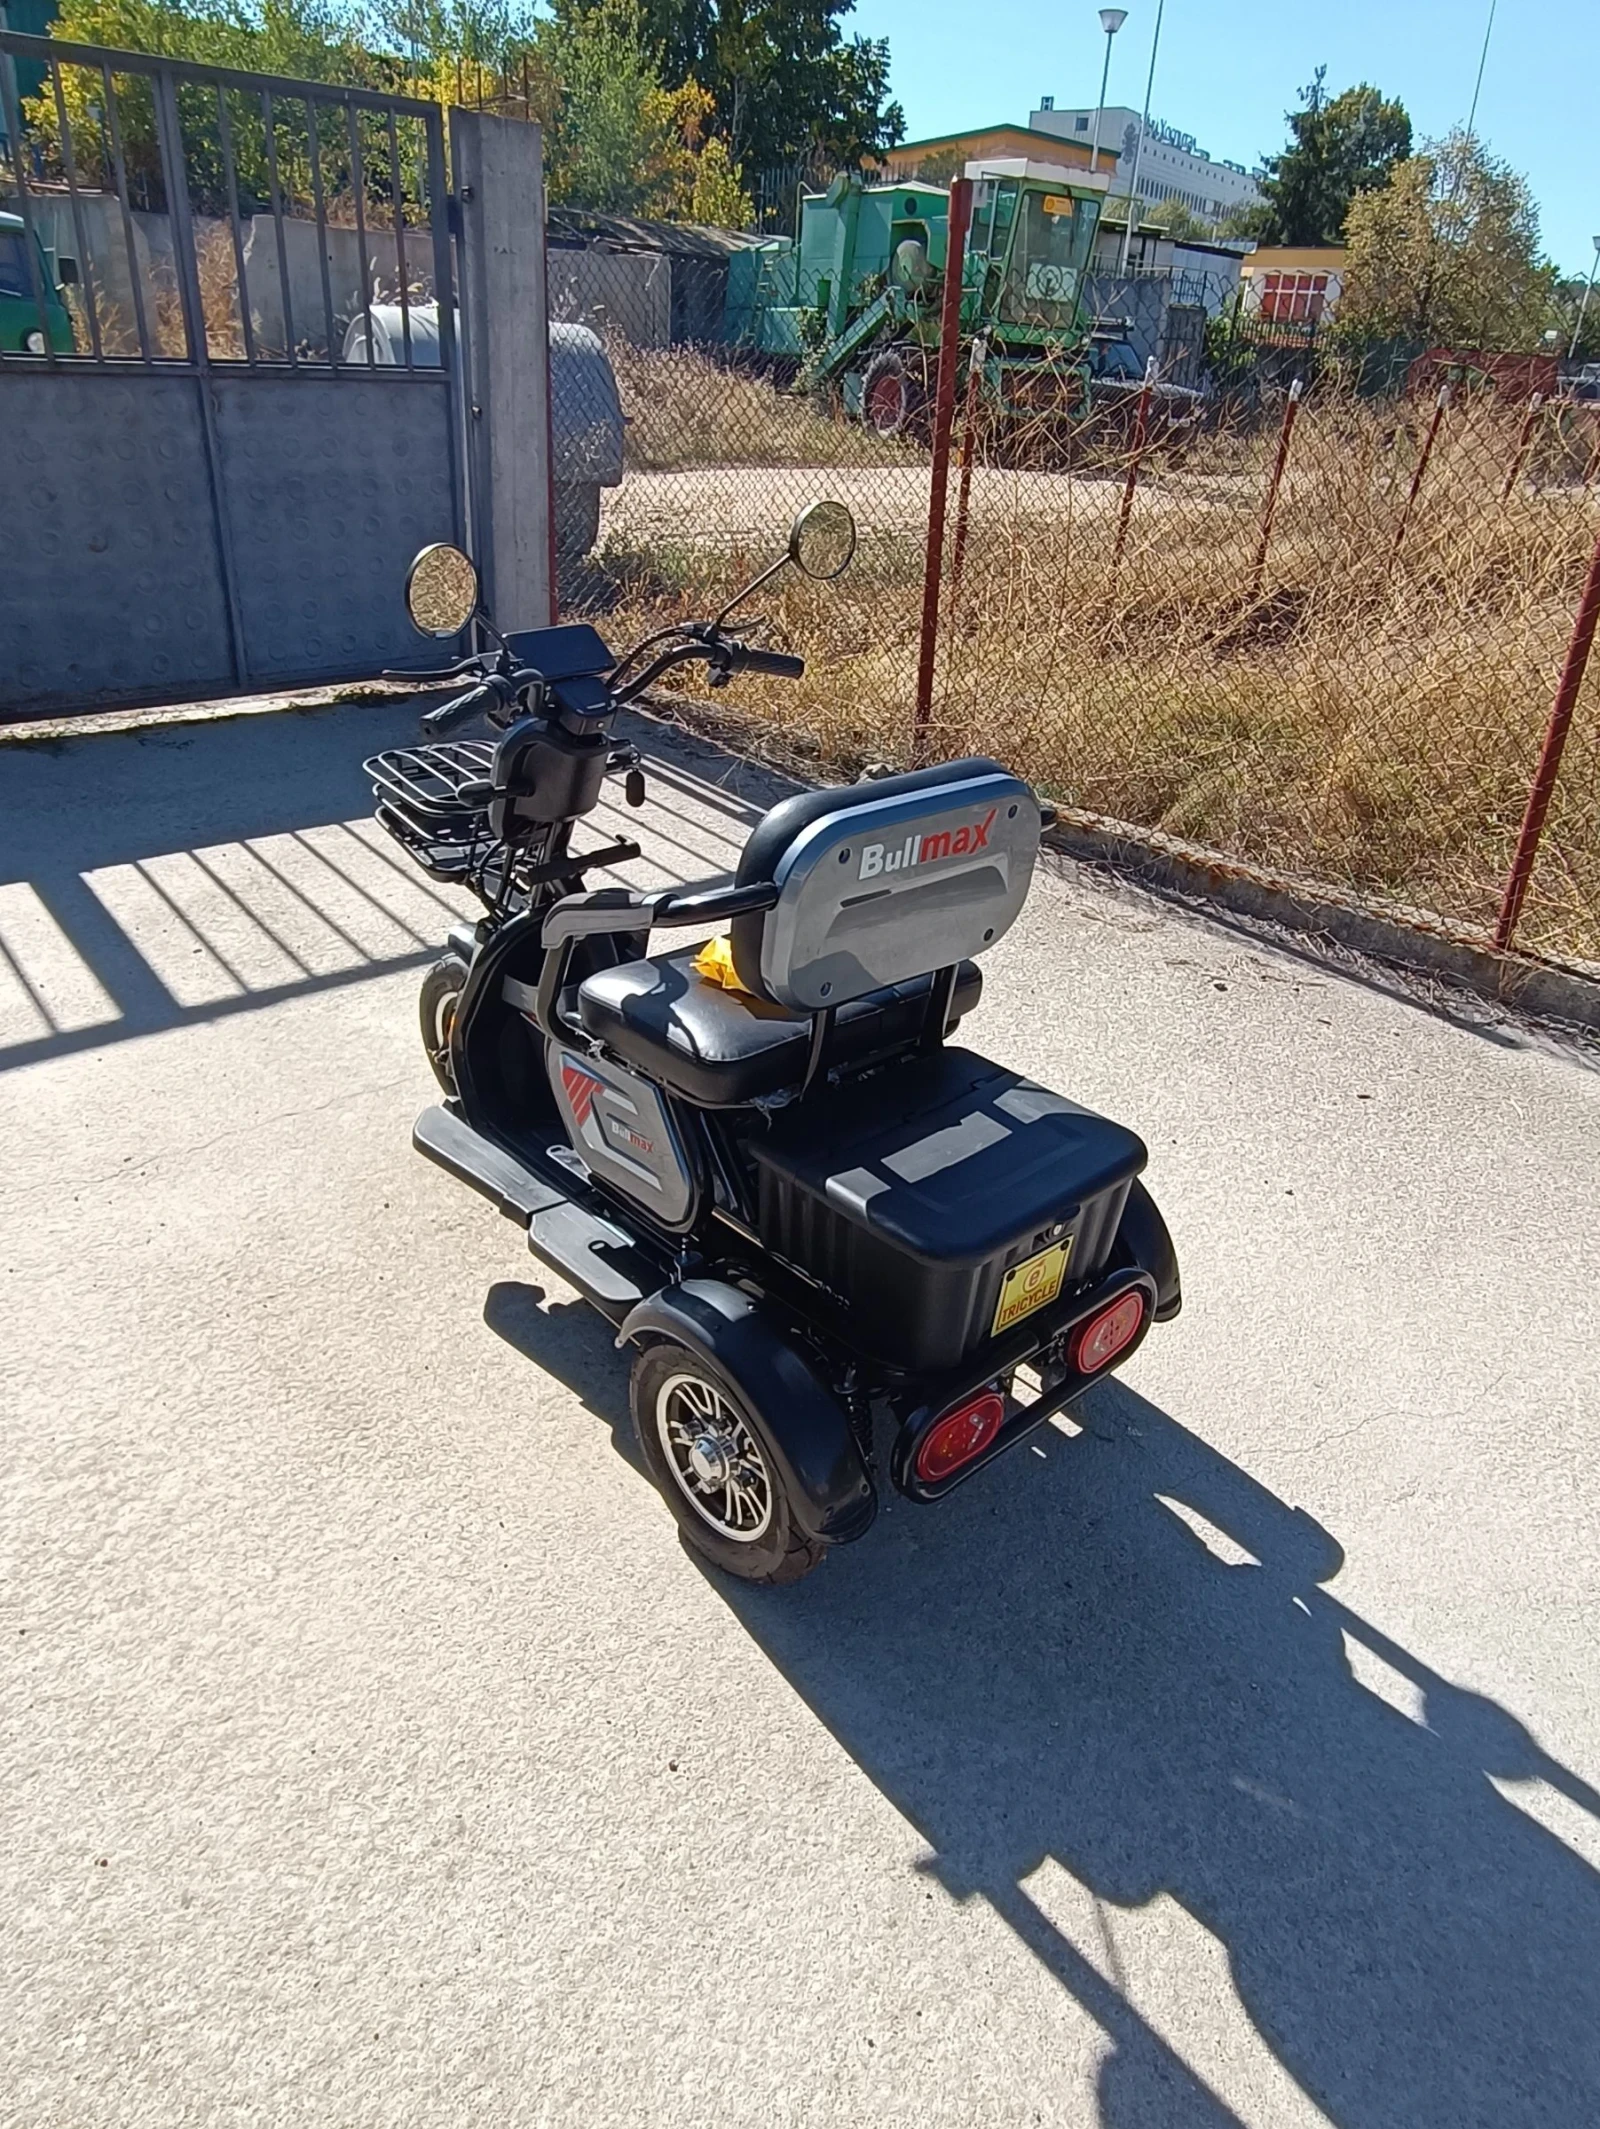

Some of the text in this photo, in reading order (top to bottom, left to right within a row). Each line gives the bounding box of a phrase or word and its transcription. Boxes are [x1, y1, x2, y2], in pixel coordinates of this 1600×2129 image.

[858, 807, 998, 880] Bullmax
[611, 1121, 654, 1153] Bullmax
[1001, 1279, 1057, 1320] TRICYCLE
